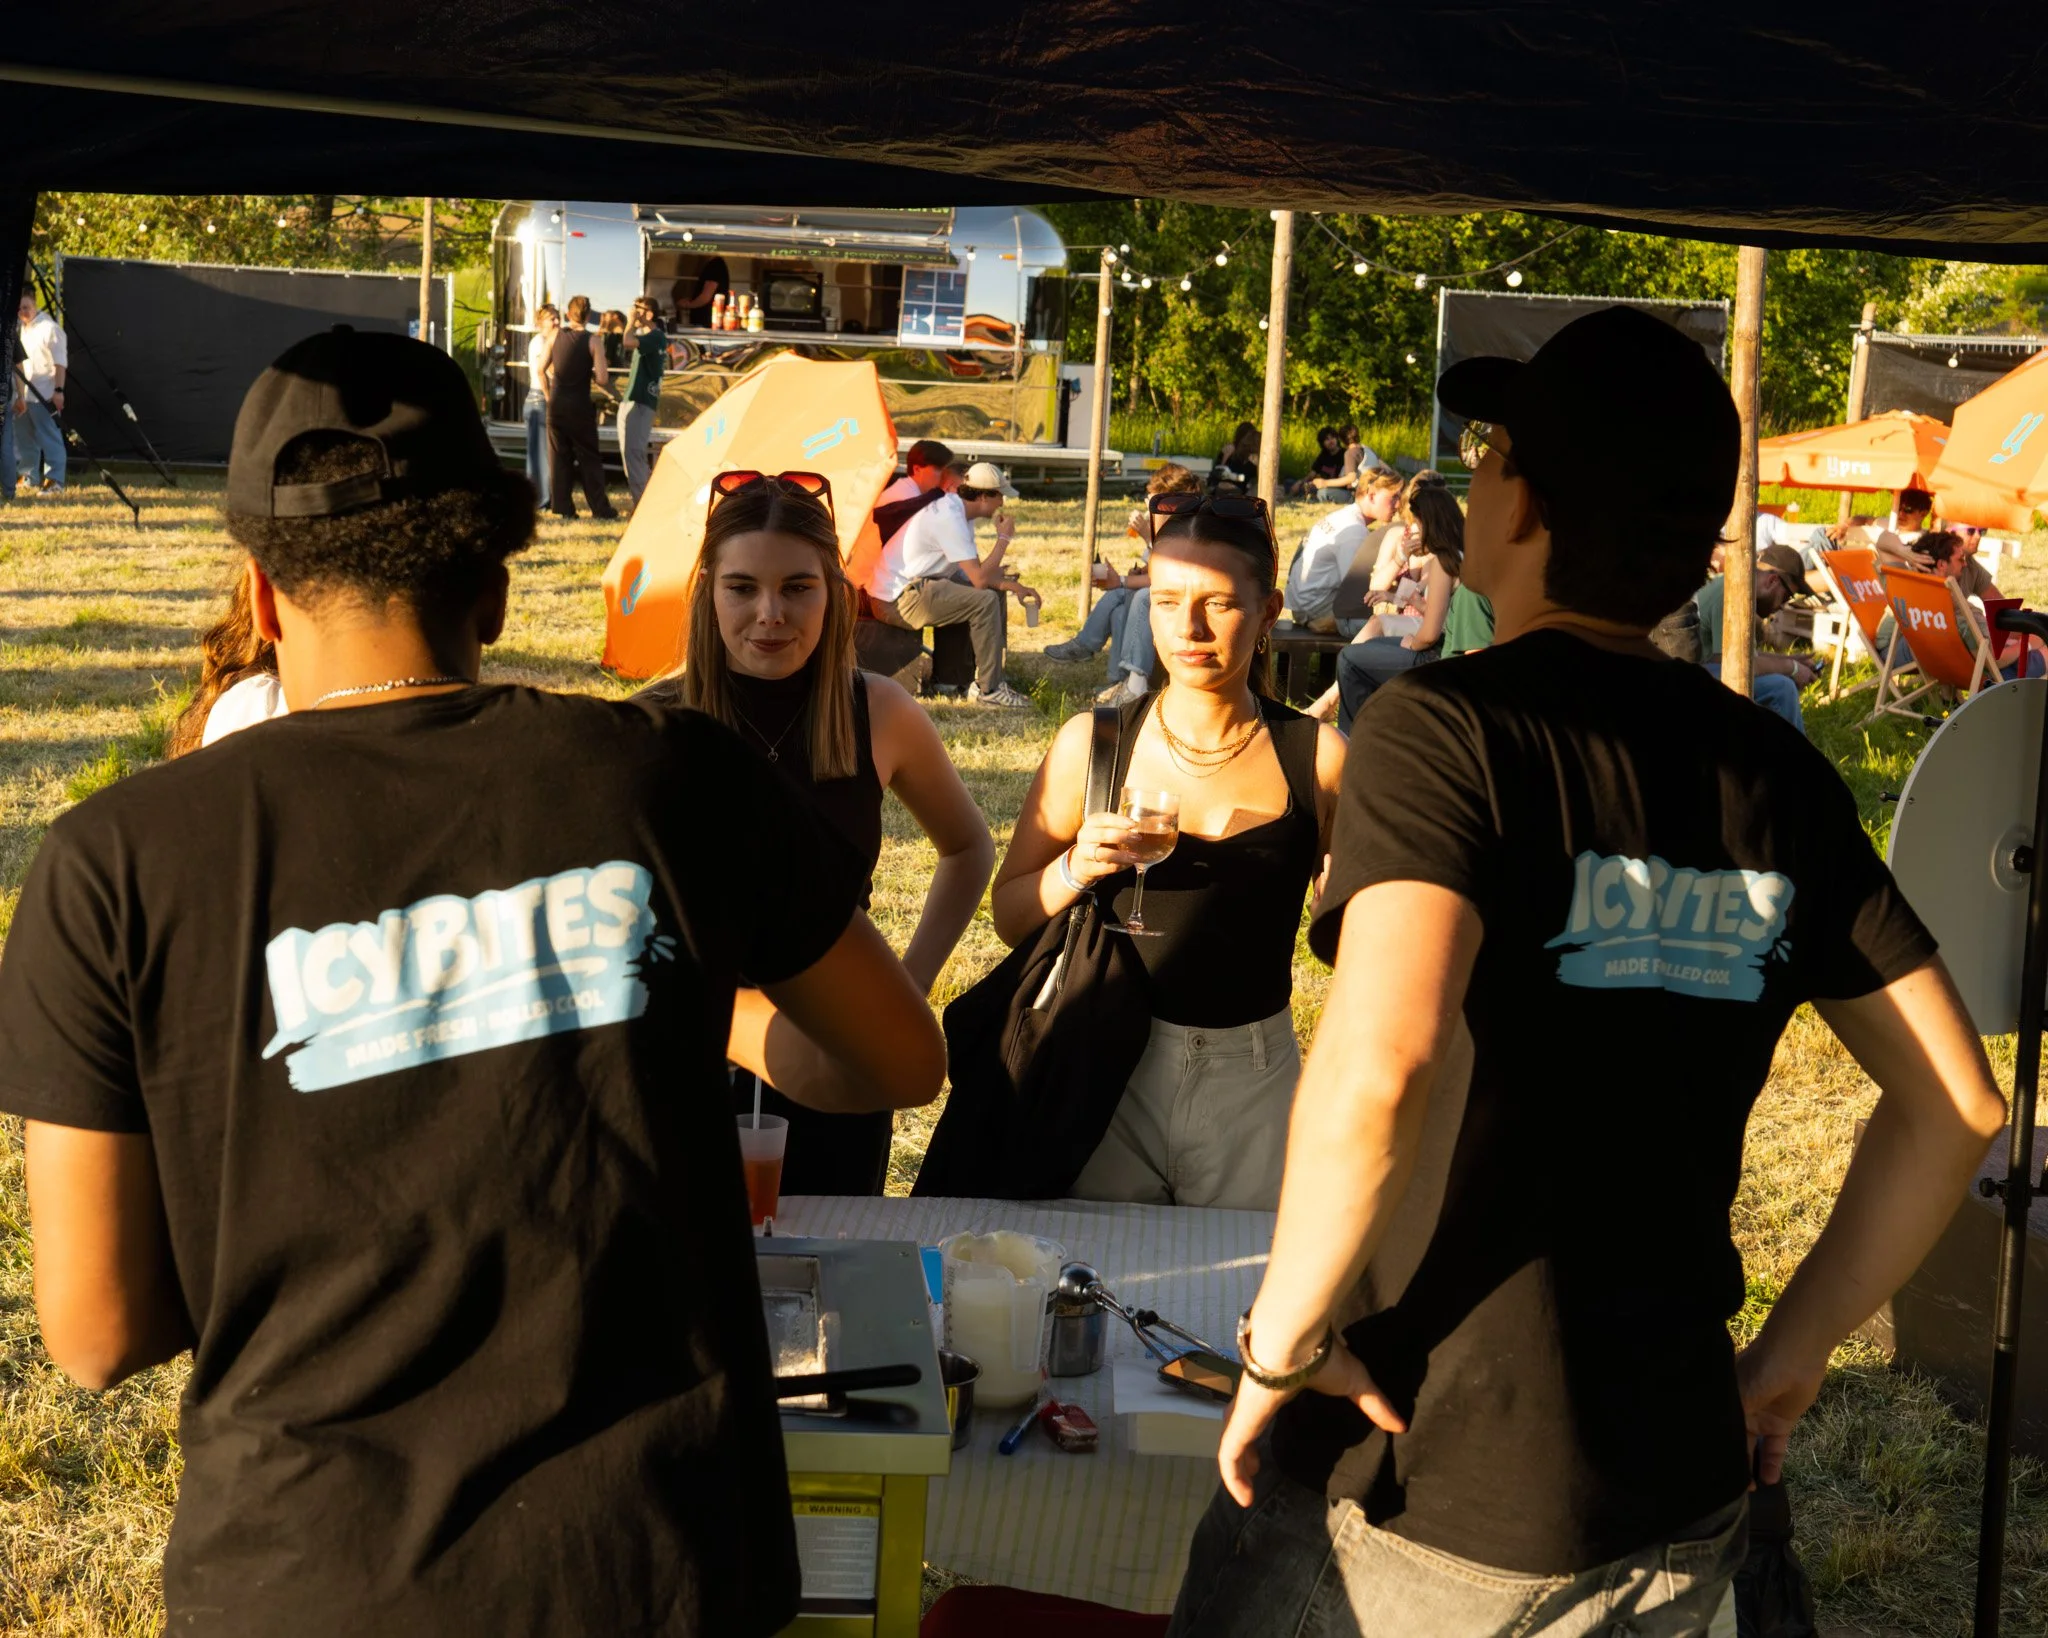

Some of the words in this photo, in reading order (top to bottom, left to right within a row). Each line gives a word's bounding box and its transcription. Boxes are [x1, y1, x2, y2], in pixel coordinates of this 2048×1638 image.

[271, 867, 640, 1031] ICYBITES
[1604, 957, 1649, 978] MADE
[345, 1031, 410, 1069] MADE
[413, 1016, 478, 1048] FRESH
[556, 988, 606, 1015] COOL
[809, 1504, 861, 1515] WARNING
